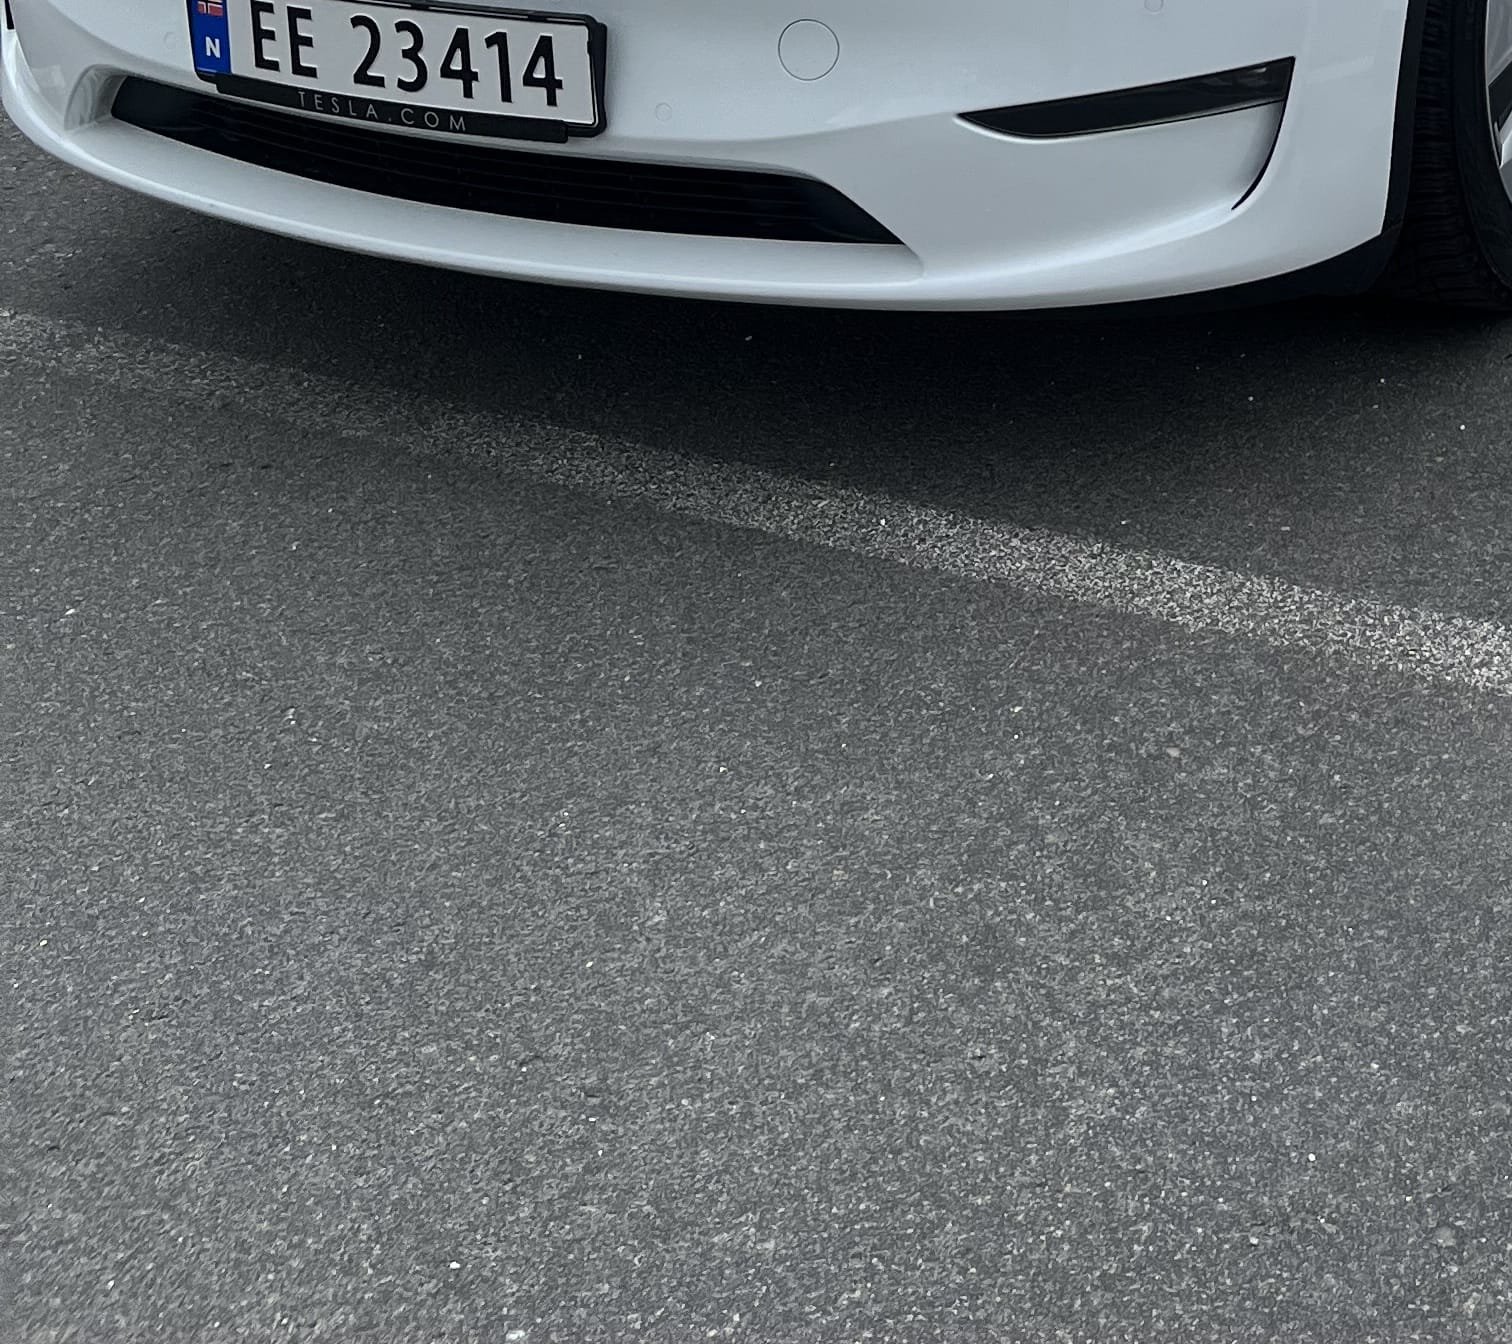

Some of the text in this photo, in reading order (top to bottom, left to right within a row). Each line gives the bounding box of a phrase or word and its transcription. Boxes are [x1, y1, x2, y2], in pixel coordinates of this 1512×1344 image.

[206, 0, 564, 107] N EE 23414
[298, 90, 467, 132] TESLA.COM
